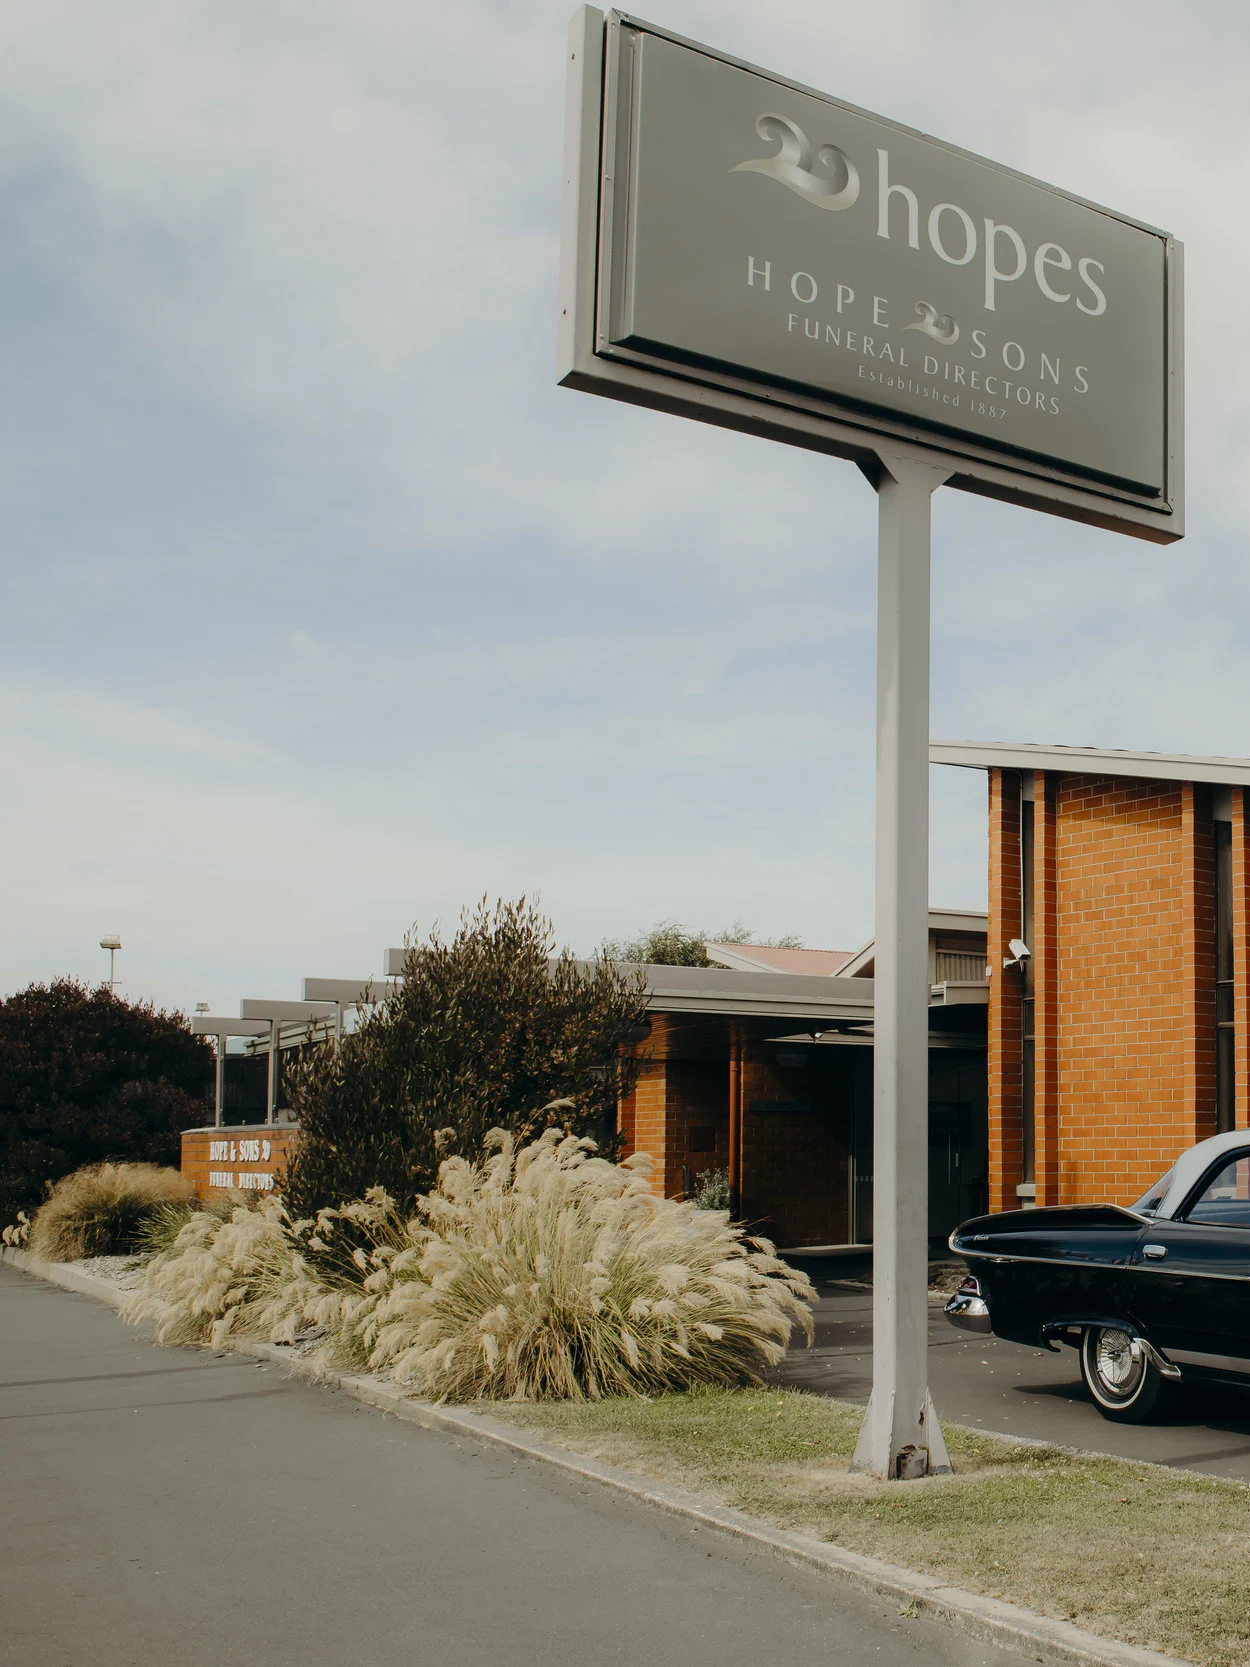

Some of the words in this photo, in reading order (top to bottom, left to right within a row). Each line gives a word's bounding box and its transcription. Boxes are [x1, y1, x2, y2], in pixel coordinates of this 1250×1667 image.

[876, 148, 1107, 316] hopes
[747, 255, 889, 328] HOPE
[970, 330, 1089, 394] SONS
[788, 312, 909, 367] FUNERAL
[924, 355, 1060, 415] DIRECTORS
[858, 365, 960, 407] Established
[971, 399, 1007, 420] 1887
